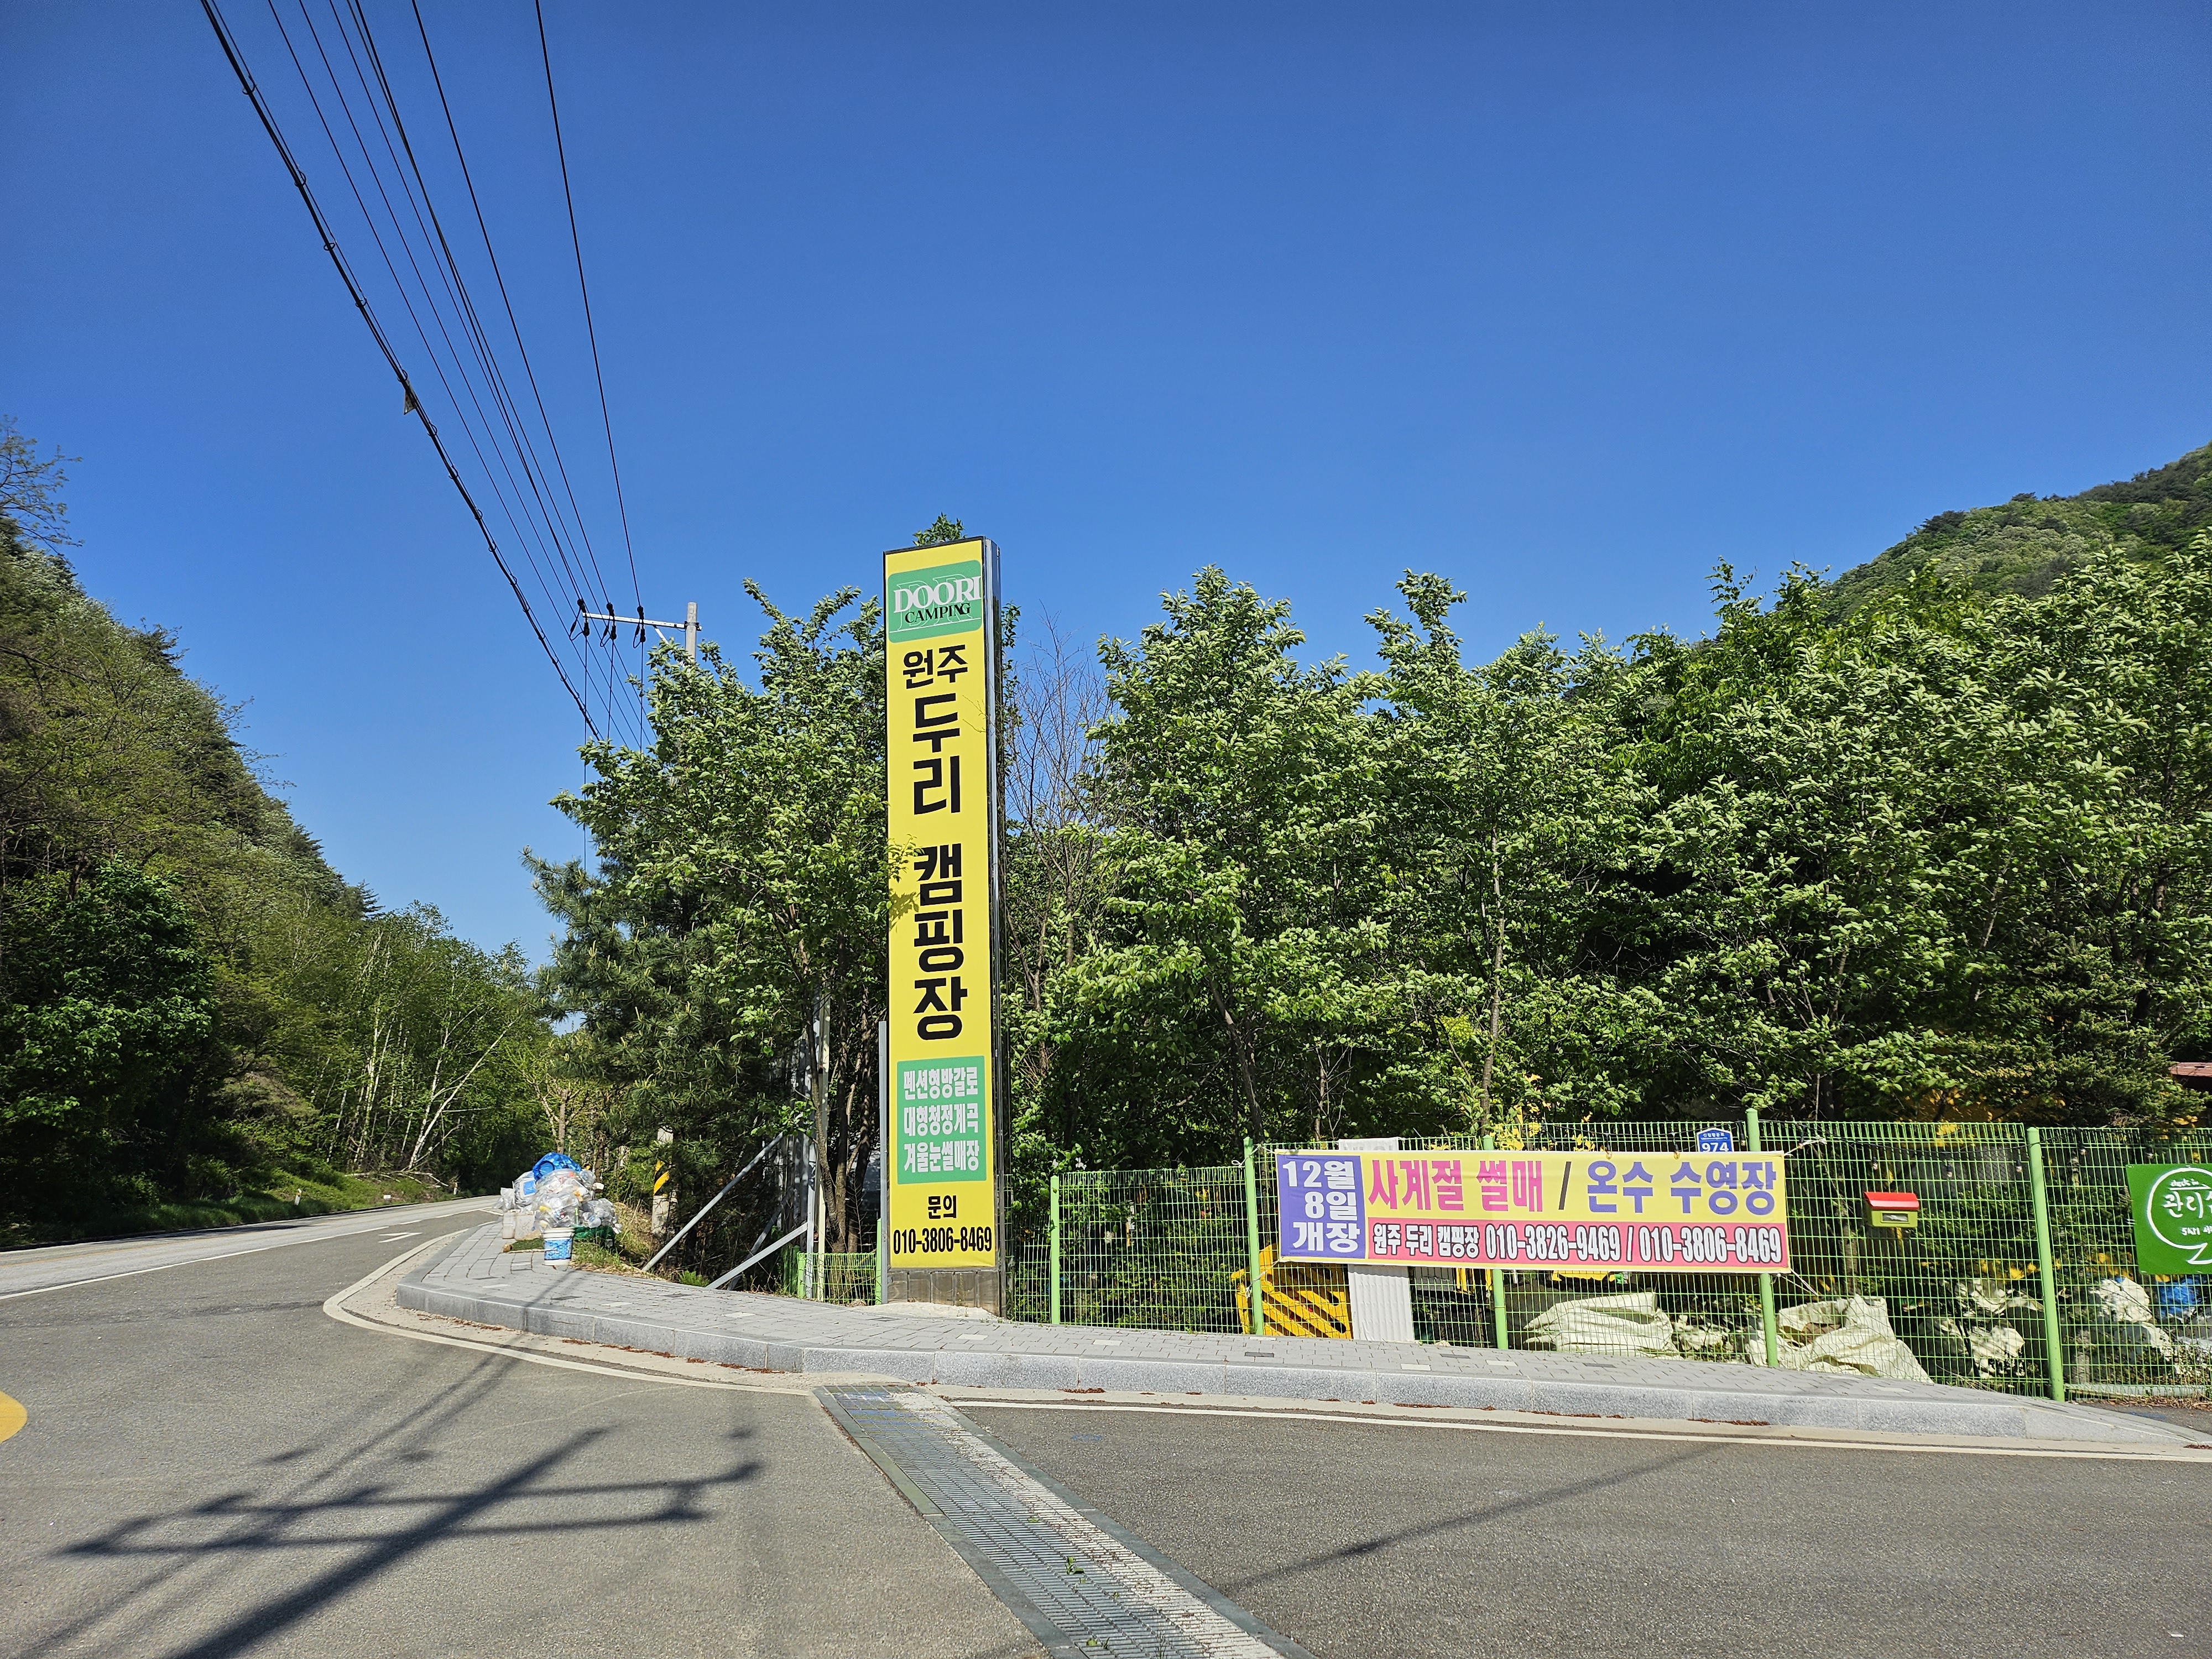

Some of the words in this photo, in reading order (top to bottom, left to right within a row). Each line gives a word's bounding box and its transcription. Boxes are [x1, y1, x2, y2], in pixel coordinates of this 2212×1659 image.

[894, 576, 982, 613] DOORI
[905, 603, 971, 623] CAMPING
[903, 645, 968, 690] 원주
[913, 693, 961, 815] 두리
[913, 843, 968, 1041] 캠핑장
[904, 1067, 978, 1100] 펜션형방갈로
[904, 1103, 979, 1136] 대형청정계곡
[904, 1140, 979, 1173] 겨울눈썰매장
[1702, 1142, 1729, 1152] 974
[1282, 1161, 1356, 1190] 12월
[1369, 1160, 1464, 1211] 사계절
[1476, 1160, 1542, 1212] 썰매
[1558, 1161, 1572, 1211] /
[1587, 1160, 1653, 1213] 온수
[1670, 1161, 1777, 1215] 수영장
[927, 1195, 957, 1219] 문의
[1305, 1191, 1358, 1221] 8일
[893, 1226, 992, 1254] 010-3806-8469
[1292, 1222, 1360, 1253] 개장
[1374, 1223, 1401, 1255] 원주
[1405, 1224, 1433, 1256] 두리
[1437, 1224, 1480, 1259] 캠핑장
[1485, 1223, 1621, 1261] 010-3826-9469
[1626, 1225, 1634, 1262] /
[1639, 1225, 1782, 1264] 010-3806-8469
